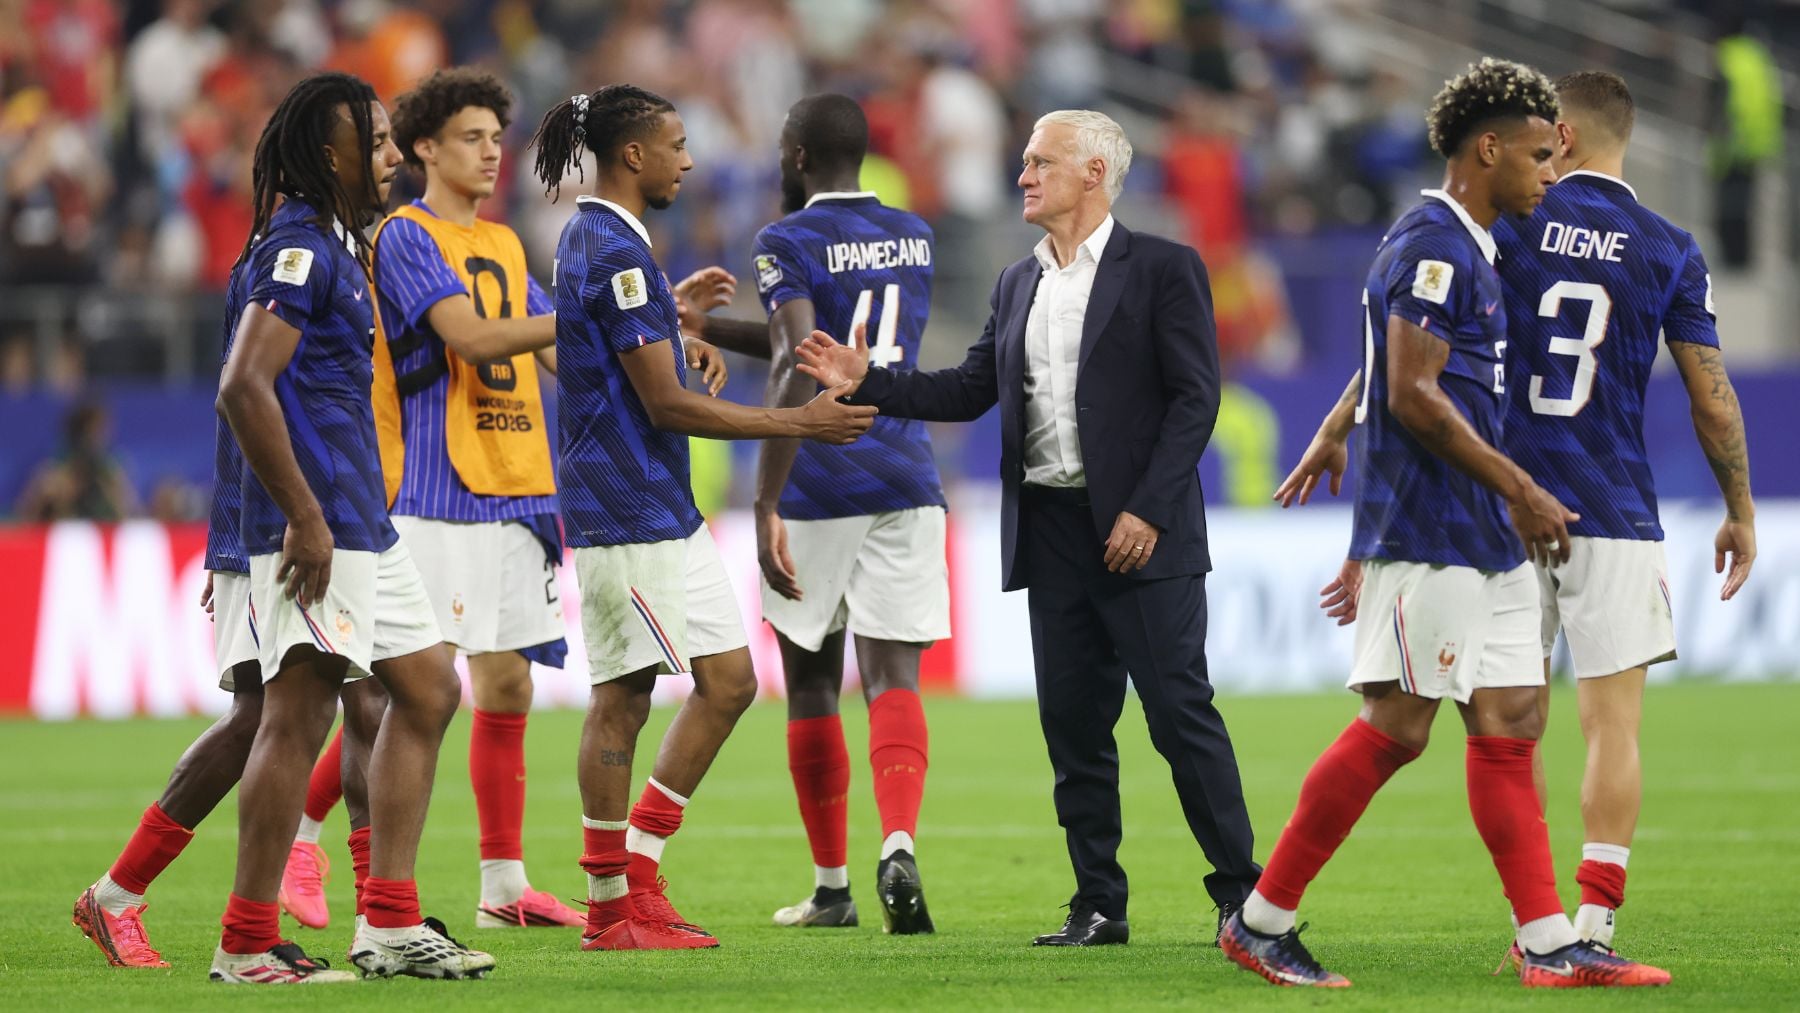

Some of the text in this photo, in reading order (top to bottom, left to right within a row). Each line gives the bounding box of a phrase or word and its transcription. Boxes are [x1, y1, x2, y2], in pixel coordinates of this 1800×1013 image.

[826, 238, 931, 273] UPAMECANO
[1540, 221, 1629, 262] DIGNE
[847, 284, 903, 367] 4
[1528, 280, 1612, 417] 3
